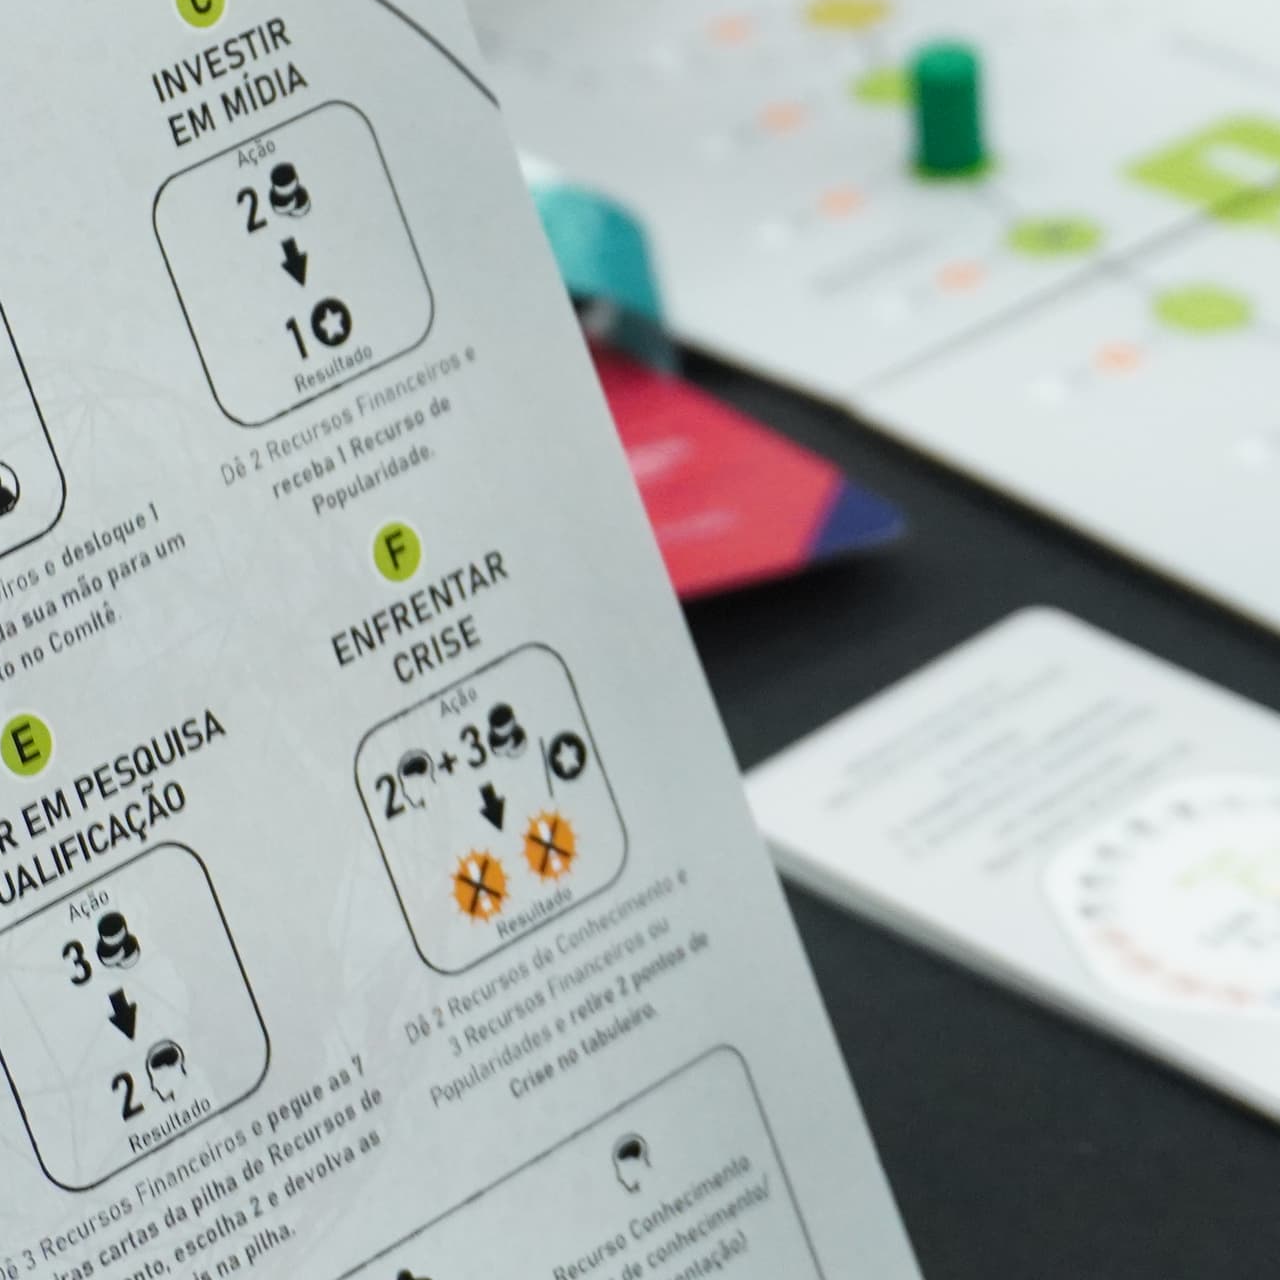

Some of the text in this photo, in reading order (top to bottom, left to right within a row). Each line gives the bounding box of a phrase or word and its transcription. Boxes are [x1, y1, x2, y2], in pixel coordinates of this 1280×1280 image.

[152, 17, 292, 104] INVESTIR
[167, 62, 308, 148] EM MÍDIA
[237, 138, 277, 169] Ação
[236, 187, 268, 234] 2
[285, 317, 308, 360] 1
[293, 343, 374, 394] Resultado
[220, 455, 247, 487] Dê
[265, 407, 354, 463] Recursos
[355, 353, 462, 417] Financeiros
[464, 346, 476, 363] e
[272, 457, 336, 500] receba
[349, 410, 425, 459] Recurso
[429, 396, 451, 419] de
[44, 560, 56, 577] e
[61, 514, 146, 568] desloque
[384, 530, 405, 571] F
[21, 600, 58, 629] sua
[61, 574, 103, 609] mão
[106, 552, 152, 591] para
[154, 533, 186, 560] um
[331, 551, 508, 667] ENFRENTAR
[20, 646, 45, 670] no
[393, 615, 481, 684] CRISE
[10, 722, 41, 765] E
[375, 725, 488, 820] 2 3
[21, 789, 72, 839] EM
[73, 709, 226, 811] PESQUISA
[68, 890, 111, 925] Ação
[62, 940, 93, 986] 3
[111, 1072, 145, 1122] 2
[127, 1096, 212, 1154] Resultado
